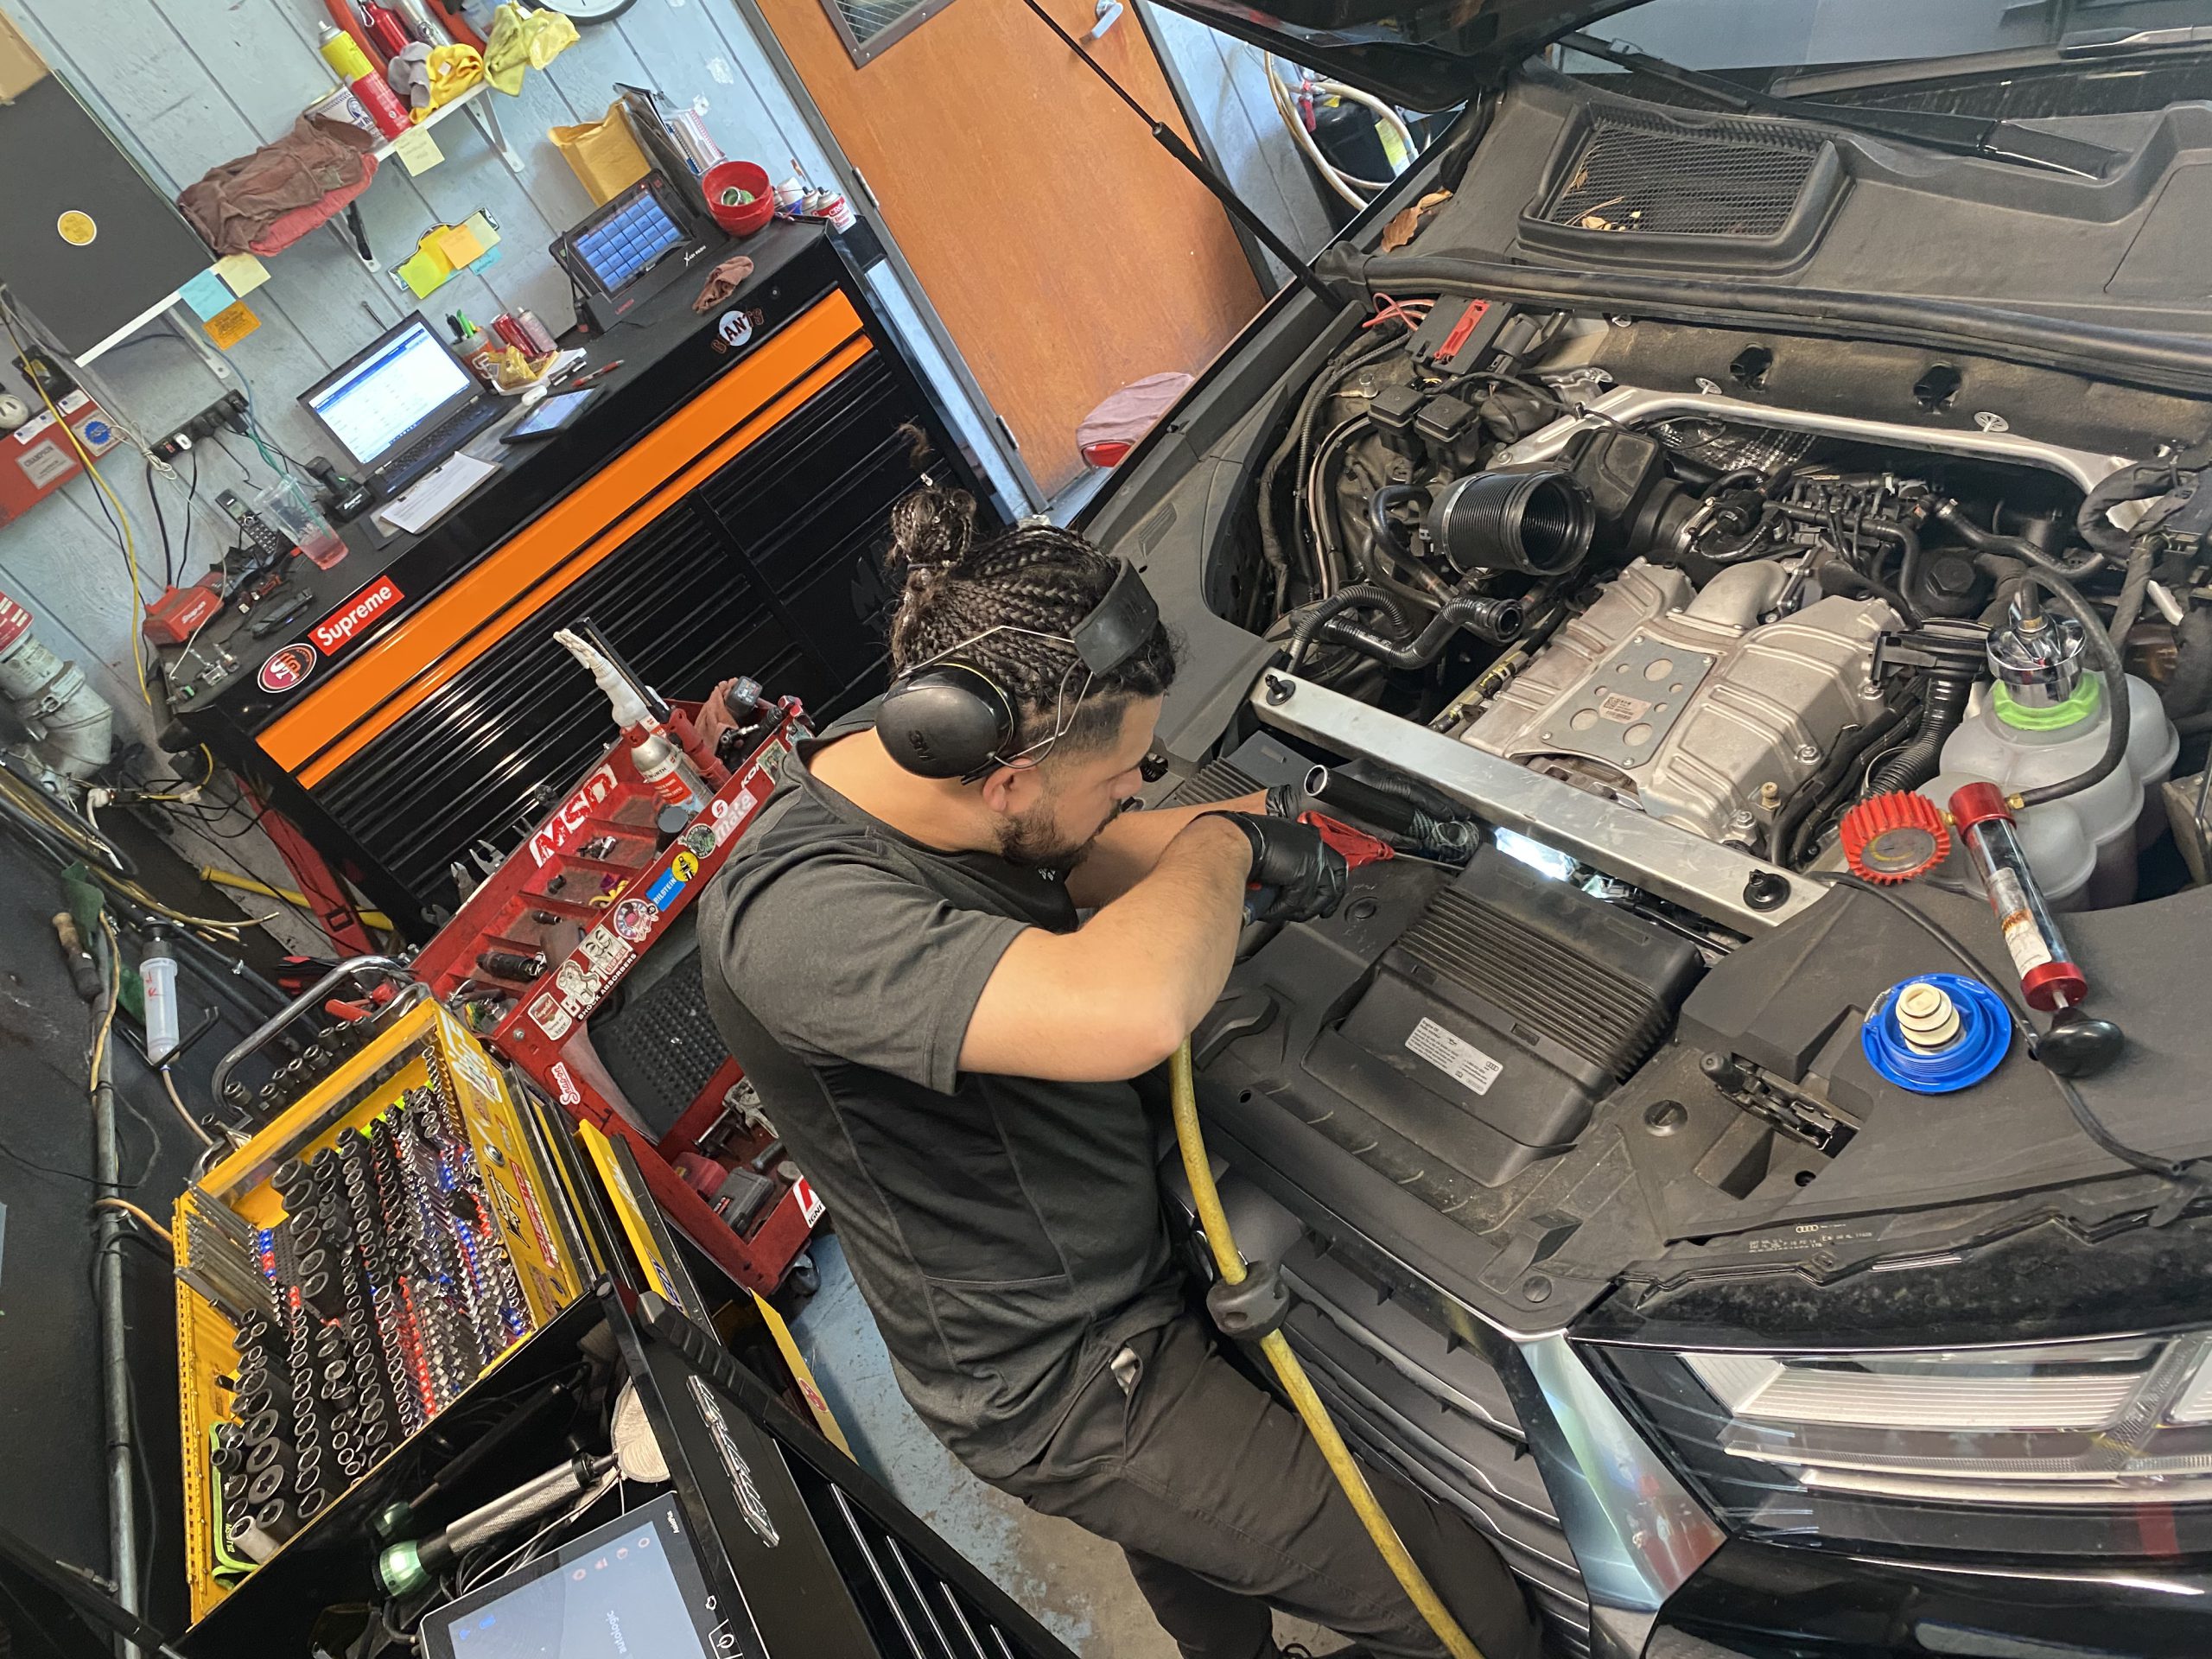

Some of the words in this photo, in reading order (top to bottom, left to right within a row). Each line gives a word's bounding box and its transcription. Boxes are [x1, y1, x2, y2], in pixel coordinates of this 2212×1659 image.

[829, 201, 845, 216] CRC
[710, 307, 765, 354] GIANTS
[317, 586, 392, 646] Supreme
[529, 763, 619, 869] MSD
[652, 877, 677, 905] BILSTEIN
[577, 995, 601, 1020] SHOCK
[601, 952, 637, 995] ABSORBERS
[553, 1064, 580, 1103] Snap-on
[606, 1609, 628, 1655] autologic
